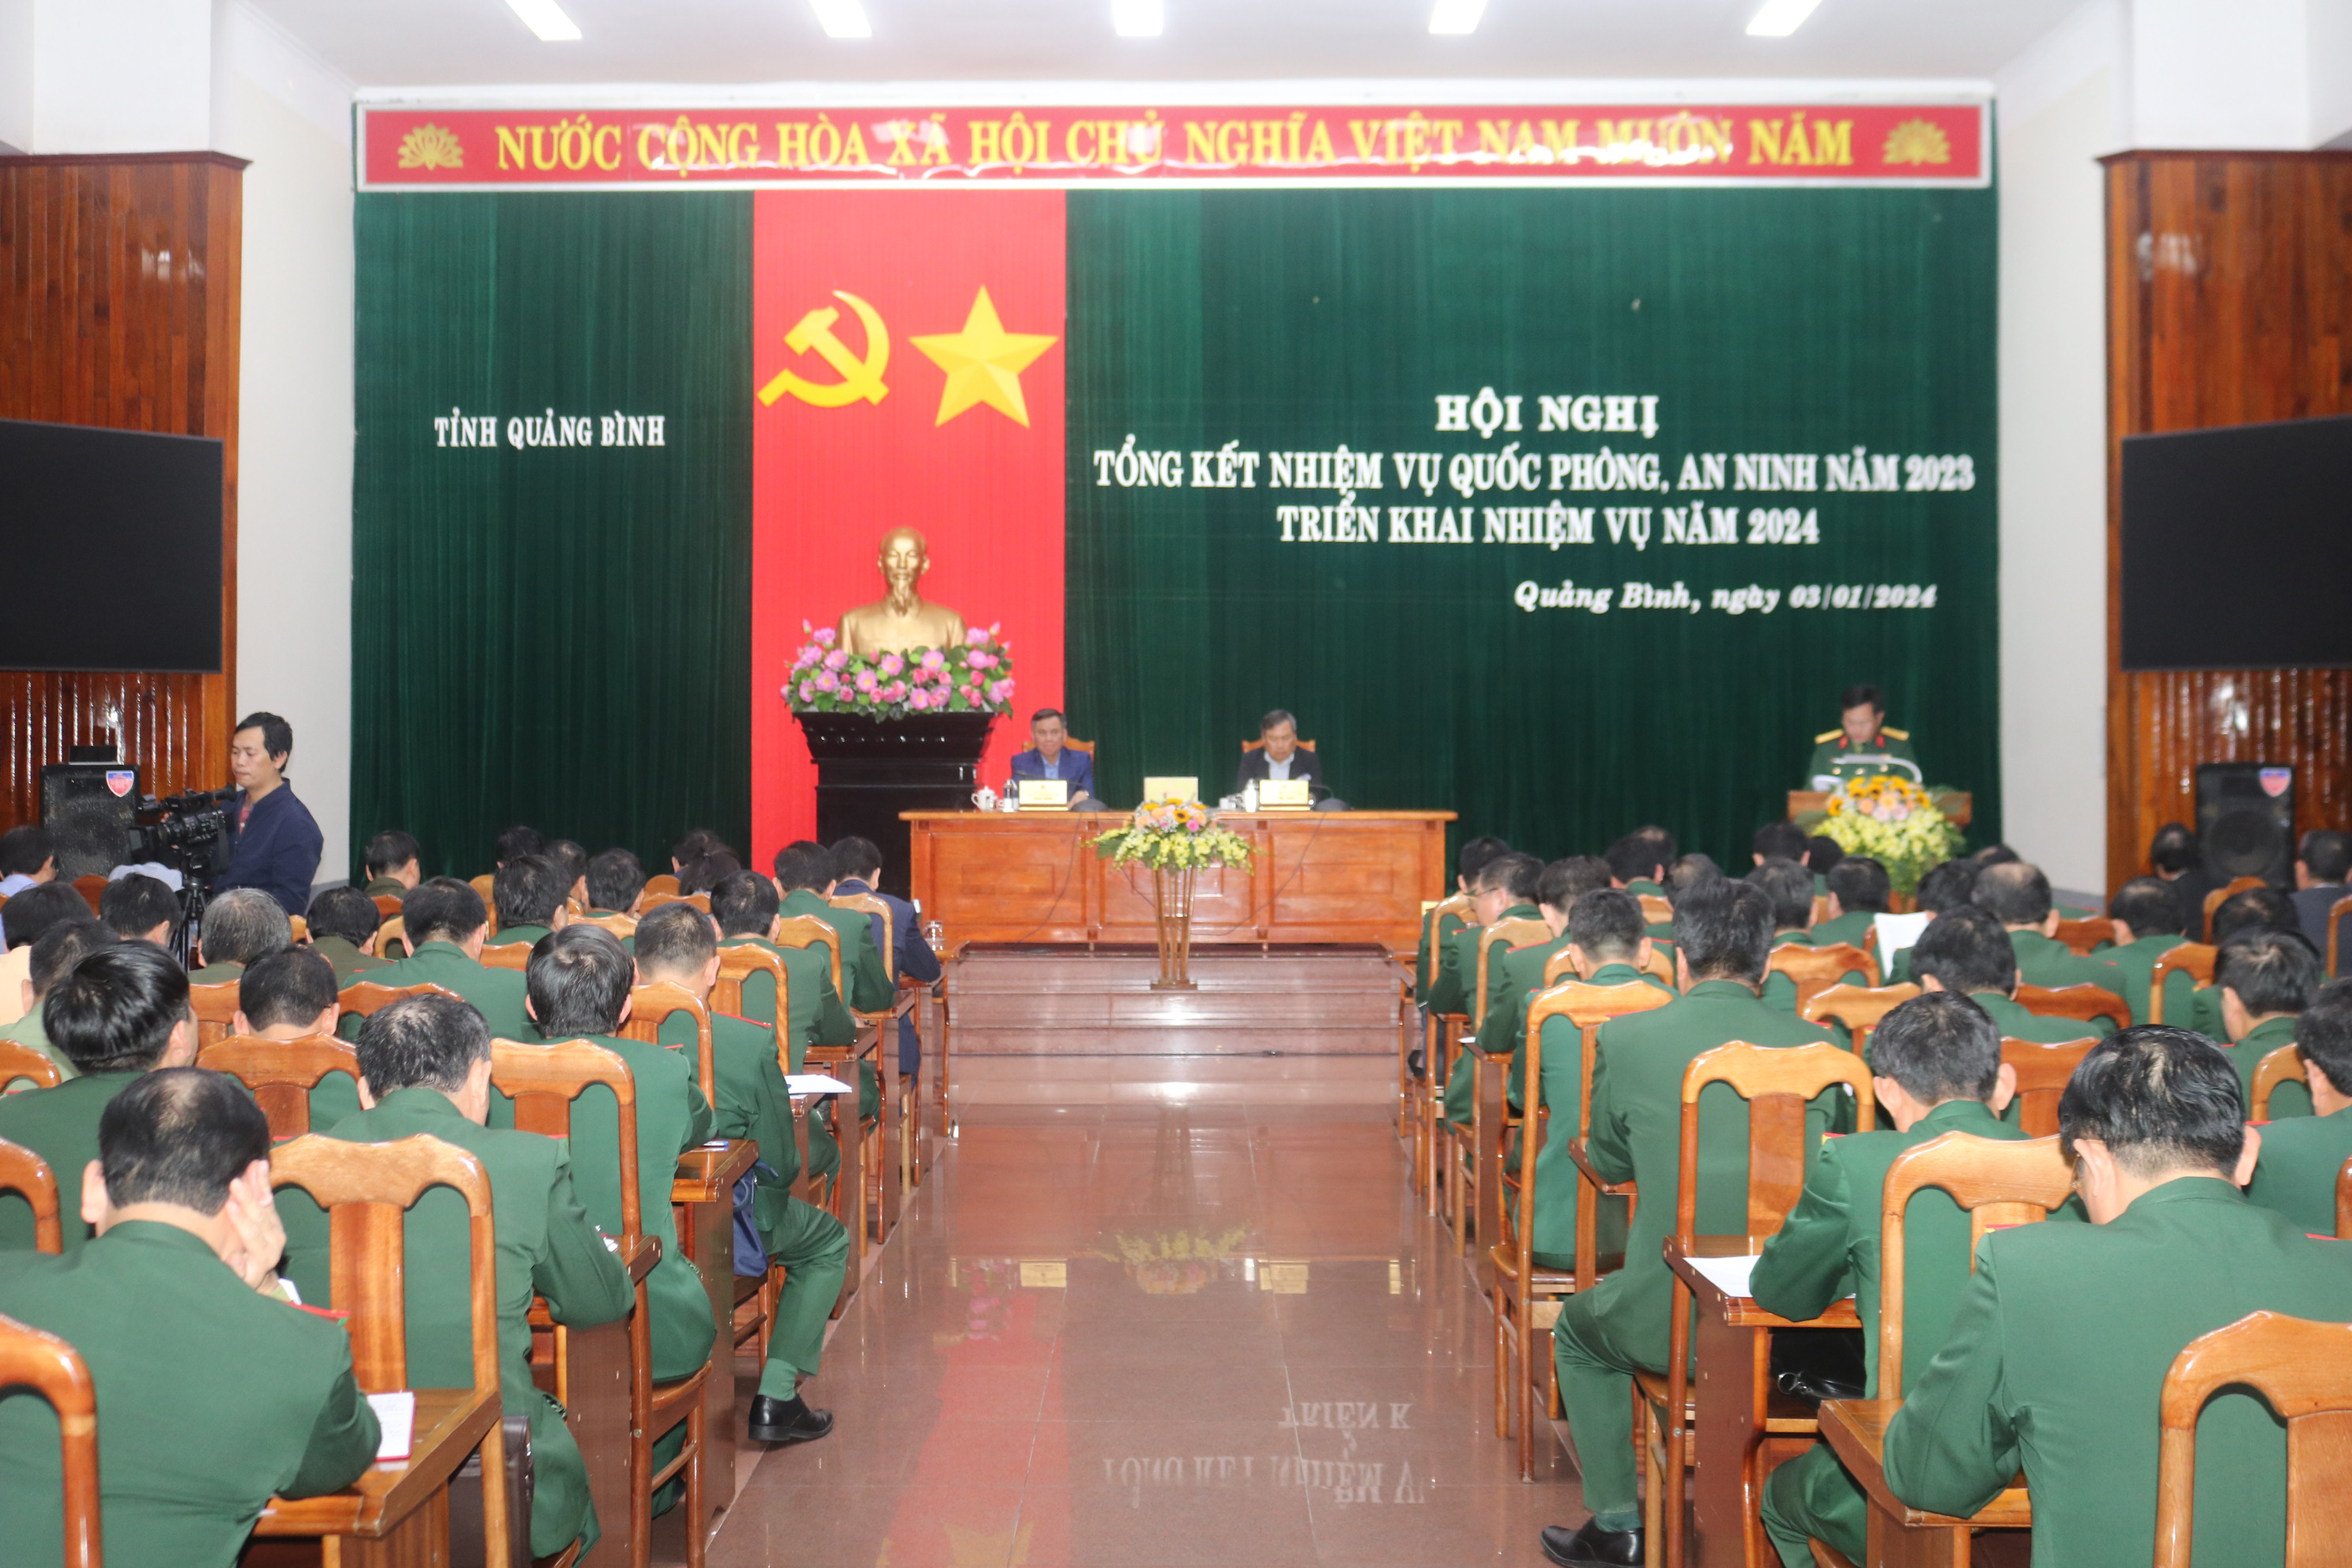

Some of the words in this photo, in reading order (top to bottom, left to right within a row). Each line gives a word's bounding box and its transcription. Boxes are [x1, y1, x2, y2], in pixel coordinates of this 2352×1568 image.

[496, 115, 622, 171] NƯỚC
[638, 115, 760, 178] CỘNG
[776, 114, 869, 166] HÒA
[889, 113, 951, 165] XÃ
[969, 111, 1050, 174] HỘI
[1066, 109, 1163, 166] CHỦ
[1185, 112, 1336, 164] NGHĨA
[1349, 111, 1462, 172] VIỆT
[1477, 119, 1581, 165] NAM
[1750, 113, 1853, 166] NĂM
[434, 406, 498, 447] TỈNH
[507, 407, 594, 450] QUẢNG
[600, 410, 665, 447] BÌNH
[1434, 386, 1523, 439] HỘI
[1537, 394, 1660, 439] NGHỊ
[1093, 433, 1185, 488] TỔNG
[1189, 439, 1261, 488] KẾT
[1268, 443, 1384, 496] NHIỆM
[1392, 452, 1443, 497] VỤ
[1448, 441, 1542, 499] QUỐC
[1548, 446, 1670, 494] PHÒNG,
[1677, 453, 1728, 491] AN
[1733, 453, 1819, 492] NINH
[1825, 447, 1900, 492] NĂM
[1905, 454, 1976, 492] 2023
[1276, 490, 1381, 543] TRIỂN
[1387, 506, 1475, 544] KHAI
[1482, 499, 1596, 552] NHIỆM
[1603, 507, 1653, 552] VỤ
[1661, 500, 1740, 545] NĂM
[1747, 507, 1820, 545] 2024
[1514, 579, 1614, 614] Quảng
[1619, 581, 1702, 614] Bình,
[1711, 584, 1781, 615] ngày
[1789, 585, 1937, 609] 03/01/2024
